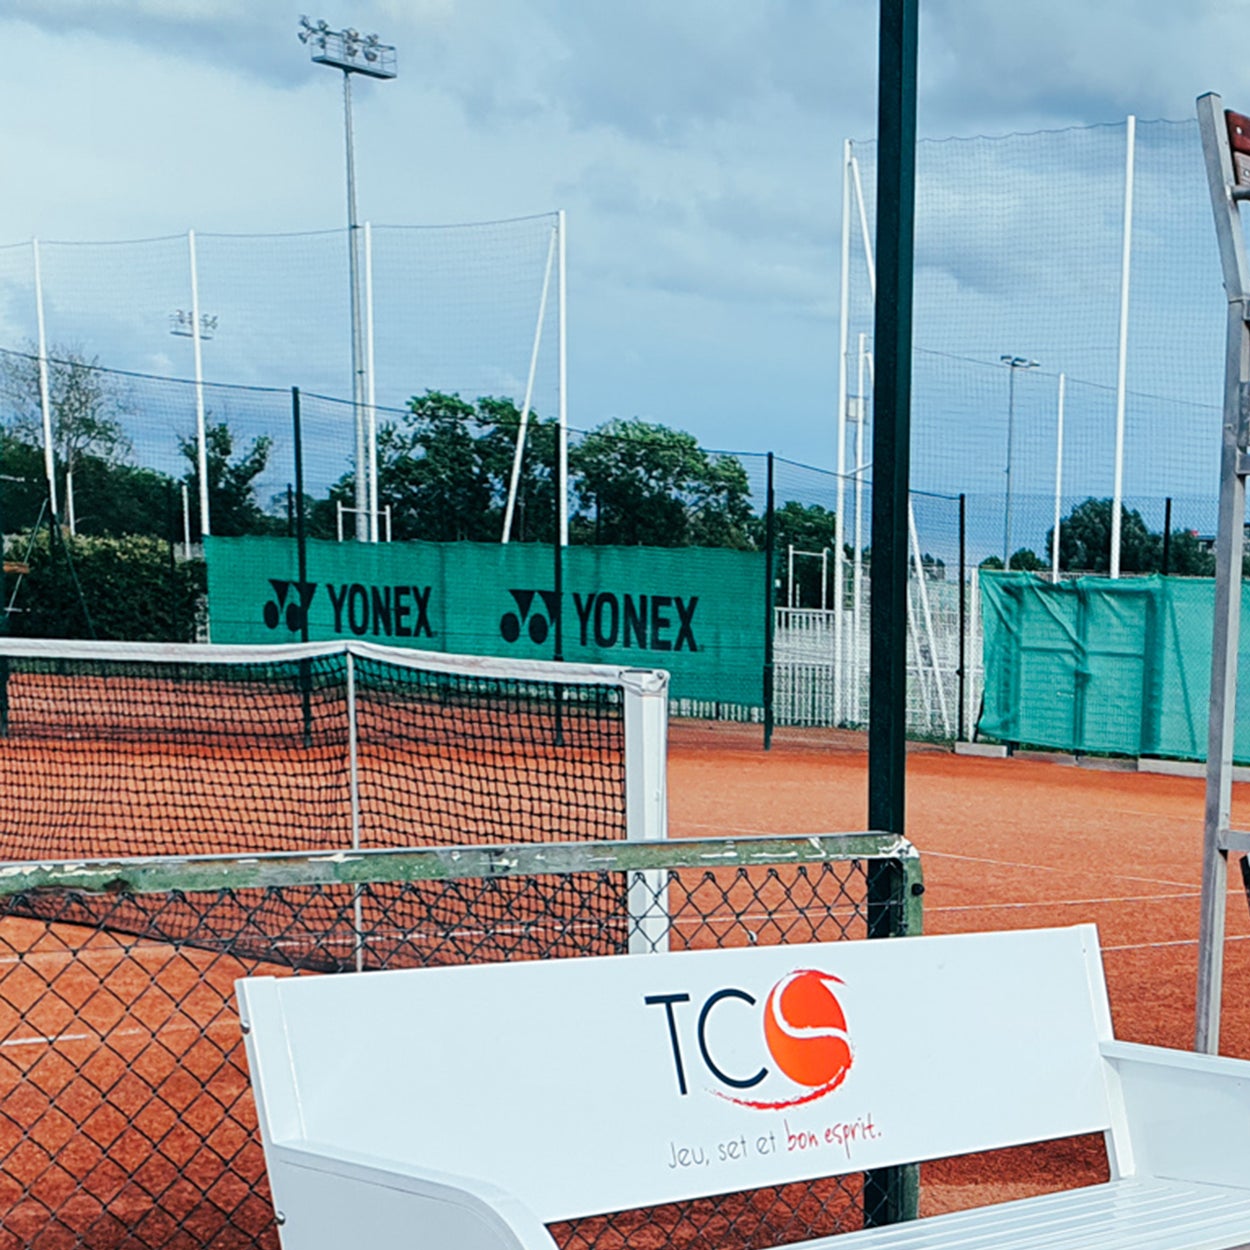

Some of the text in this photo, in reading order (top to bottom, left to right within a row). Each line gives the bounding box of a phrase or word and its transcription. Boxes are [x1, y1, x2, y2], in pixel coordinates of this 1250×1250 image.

[326, 583, 433, 638] YONEX
[573, 592, 699, 652] YONEX
[668, 1113, 882, 1169] Jeu, set et bon esprit.
